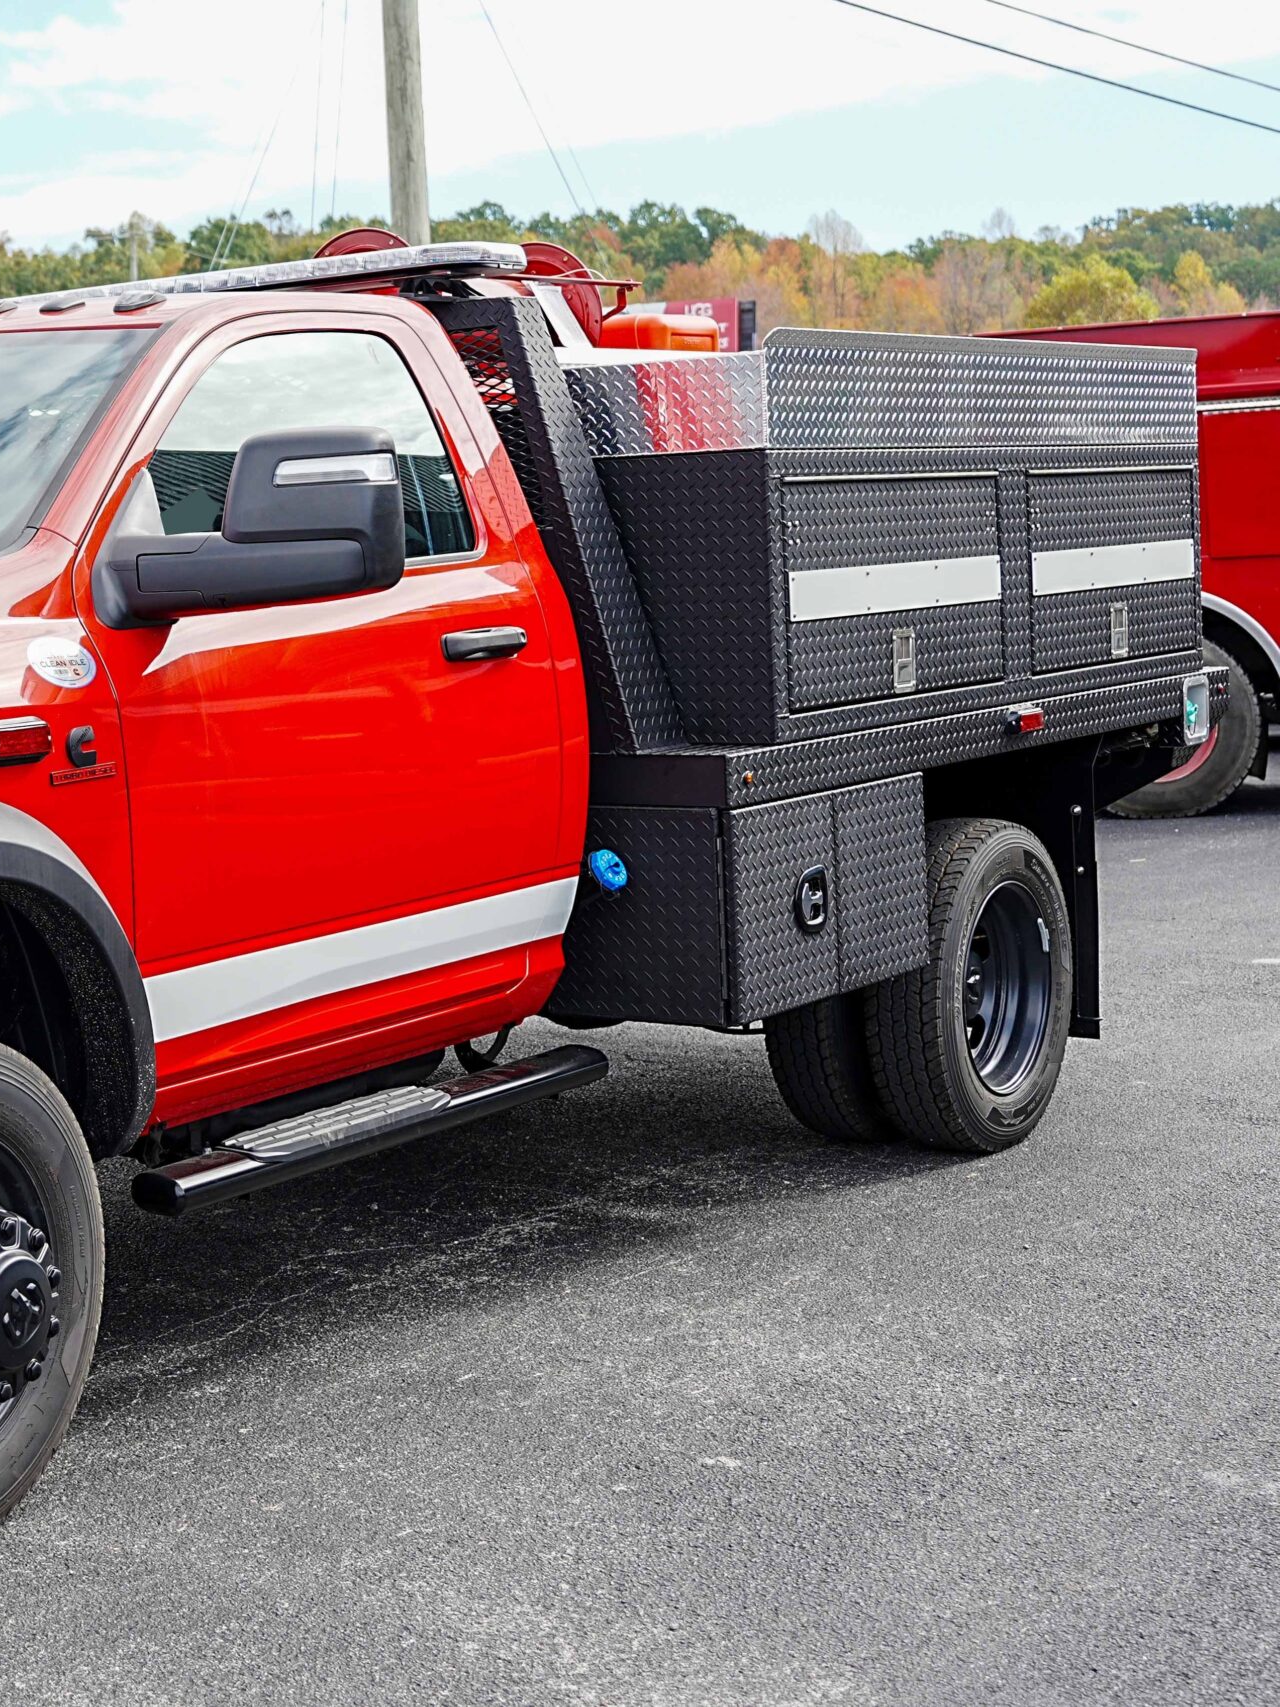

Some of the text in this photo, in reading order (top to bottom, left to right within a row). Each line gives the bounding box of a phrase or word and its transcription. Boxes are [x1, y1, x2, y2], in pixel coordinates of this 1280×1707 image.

[39, 658, 87, 668] CLEAN IDLE
[83, 764, 116, 777] DIESEL
